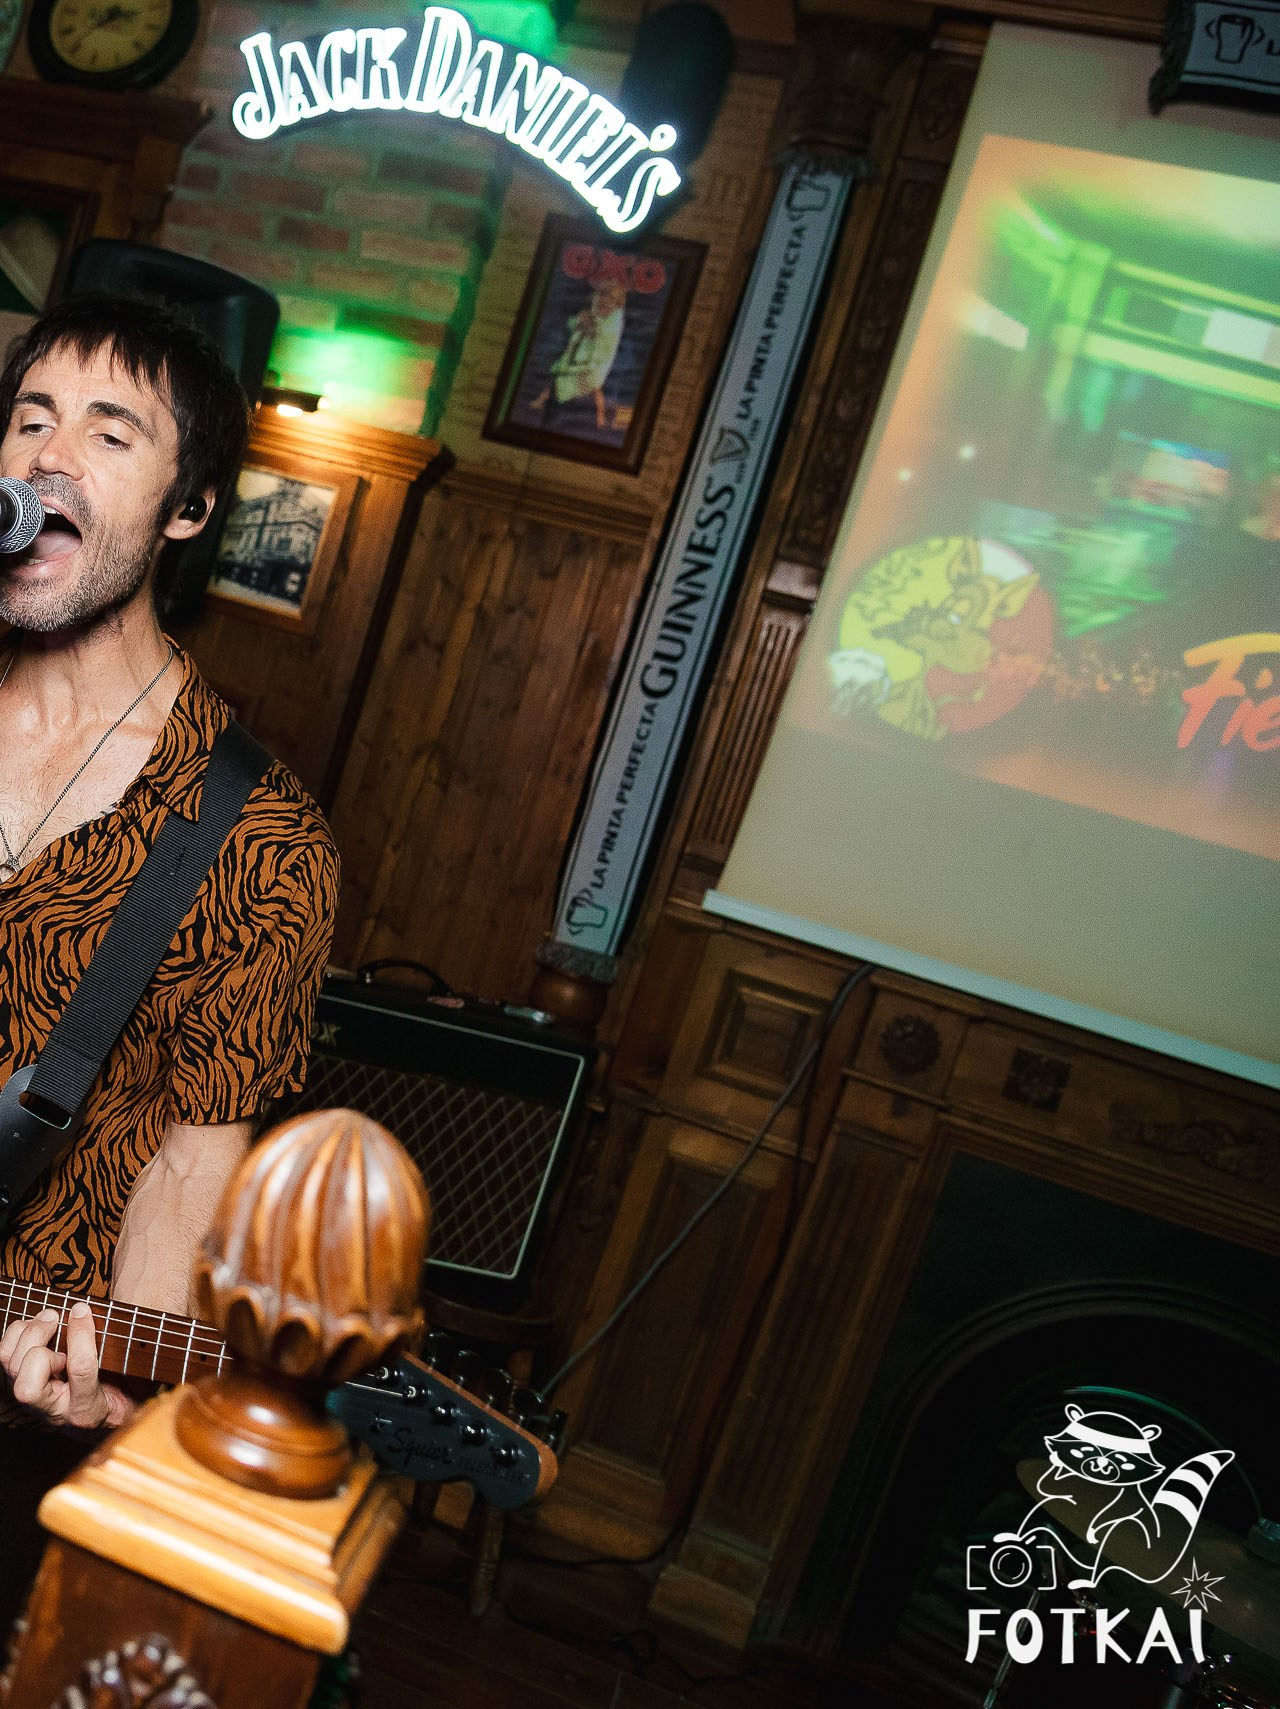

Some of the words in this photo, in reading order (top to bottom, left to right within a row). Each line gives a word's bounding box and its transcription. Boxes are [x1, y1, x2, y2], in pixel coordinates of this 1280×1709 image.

[561, 244, 668, 294] OXO
[763, 225, 808, 330] PERFECTA
[744, 331, 774, 393] PINTA
[736, 397, 753, 420] LA
[640, 474, 736, 699] GUINNESS
[616, 701, 659, 805] PERFECTA
[596, 807, 626, 865] PINTA
[591, 866, 609, 889] LA
